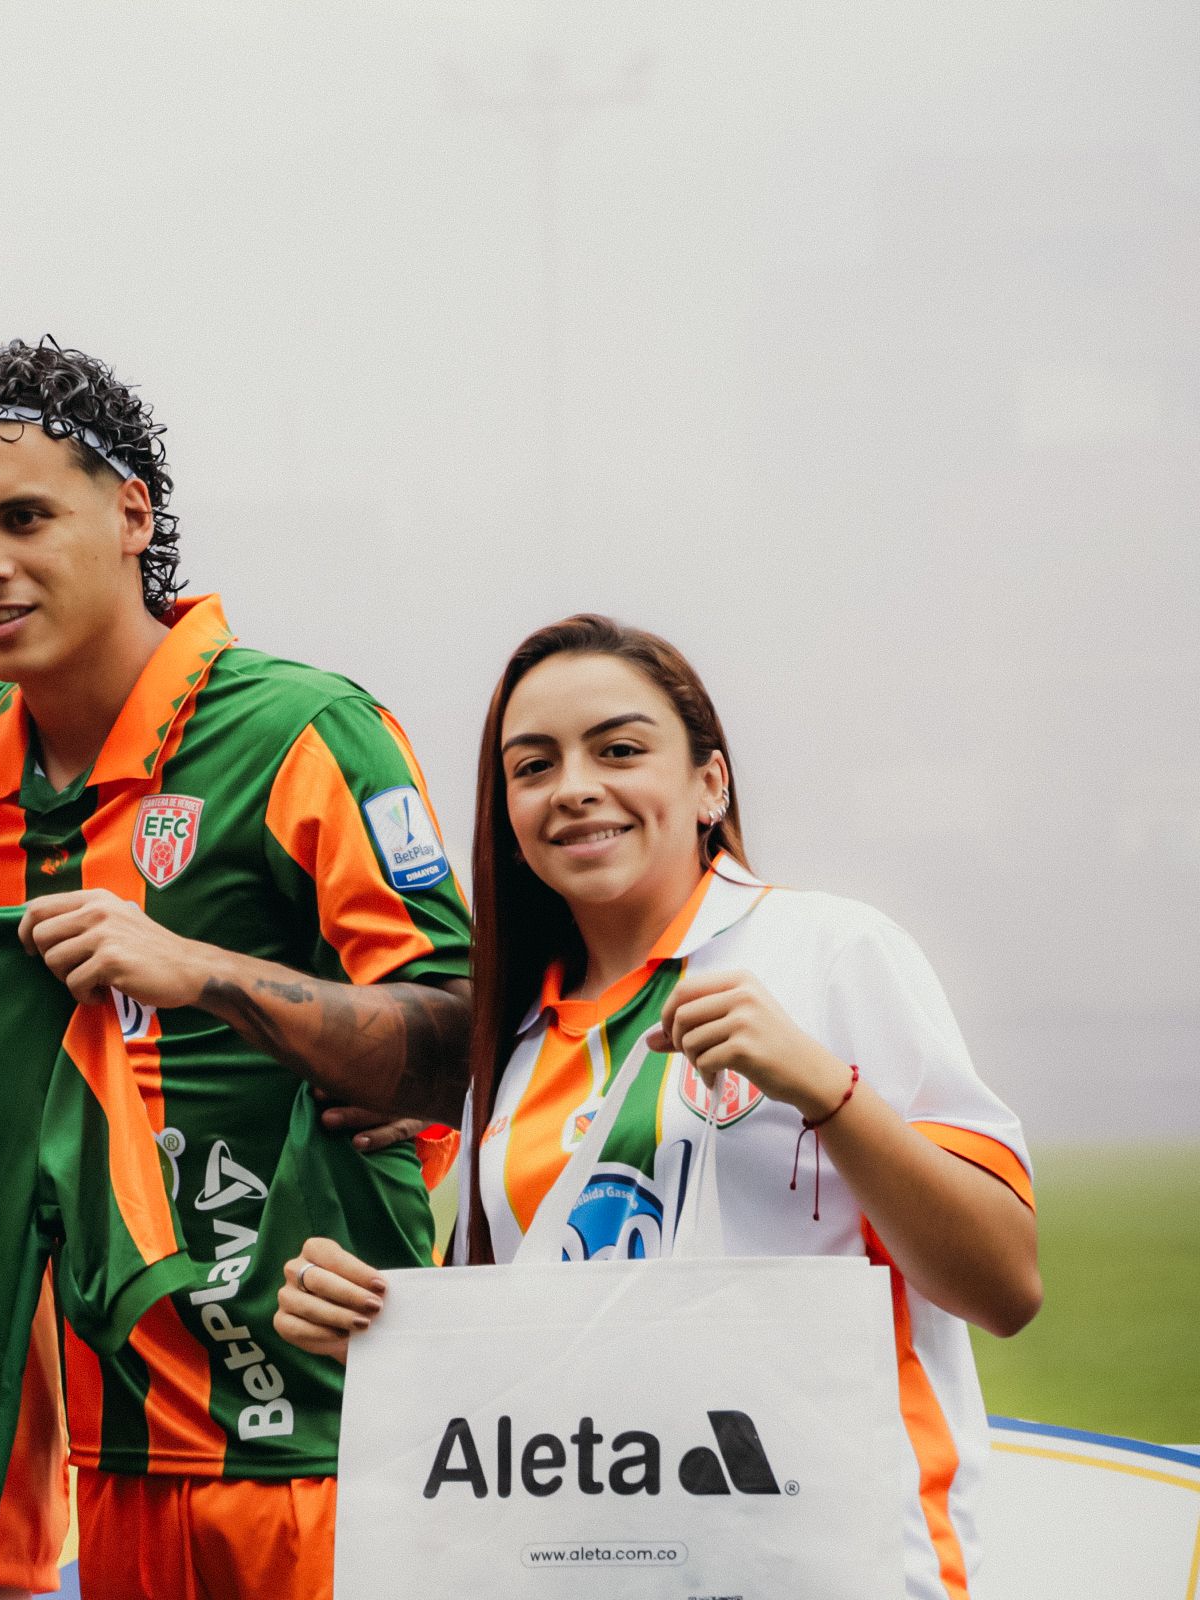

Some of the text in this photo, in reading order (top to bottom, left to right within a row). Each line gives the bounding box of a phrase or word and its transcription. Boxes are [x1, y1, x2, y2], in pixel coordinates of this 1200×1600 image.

[144, 816, 189, 838] EFC
[393, 844, 435, 864] BetPlay
[189, 1218, 295, 1441] BetPlay
[422, 1415, 661, 1499] Aleta
[530, 1547, 677, 1562] www.aleta.com.co
